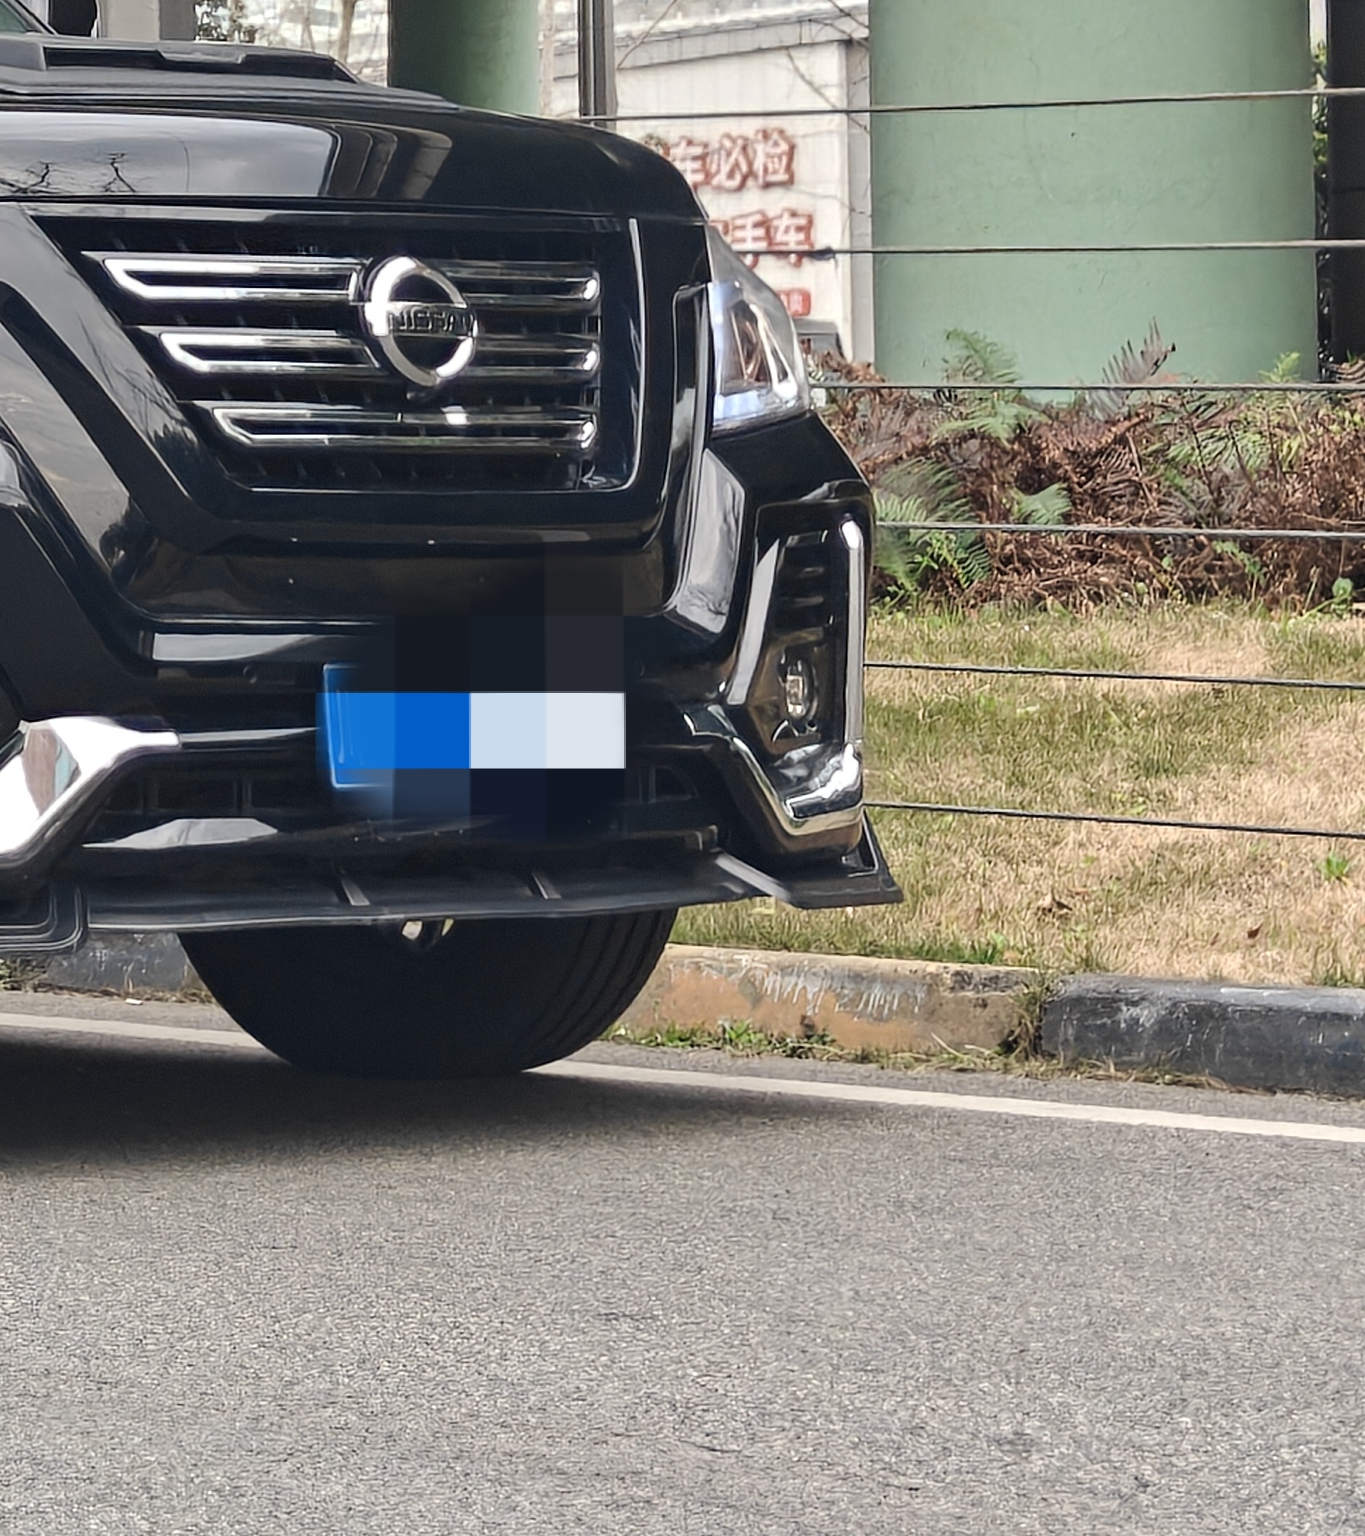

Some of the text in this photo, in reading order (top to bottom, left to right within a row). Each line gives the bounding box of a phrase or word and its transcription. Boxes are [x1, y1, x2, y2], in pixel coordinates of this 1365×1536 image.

[643, 127, 797, 191] 车必检
[709, 208, 815, 268] 手车
